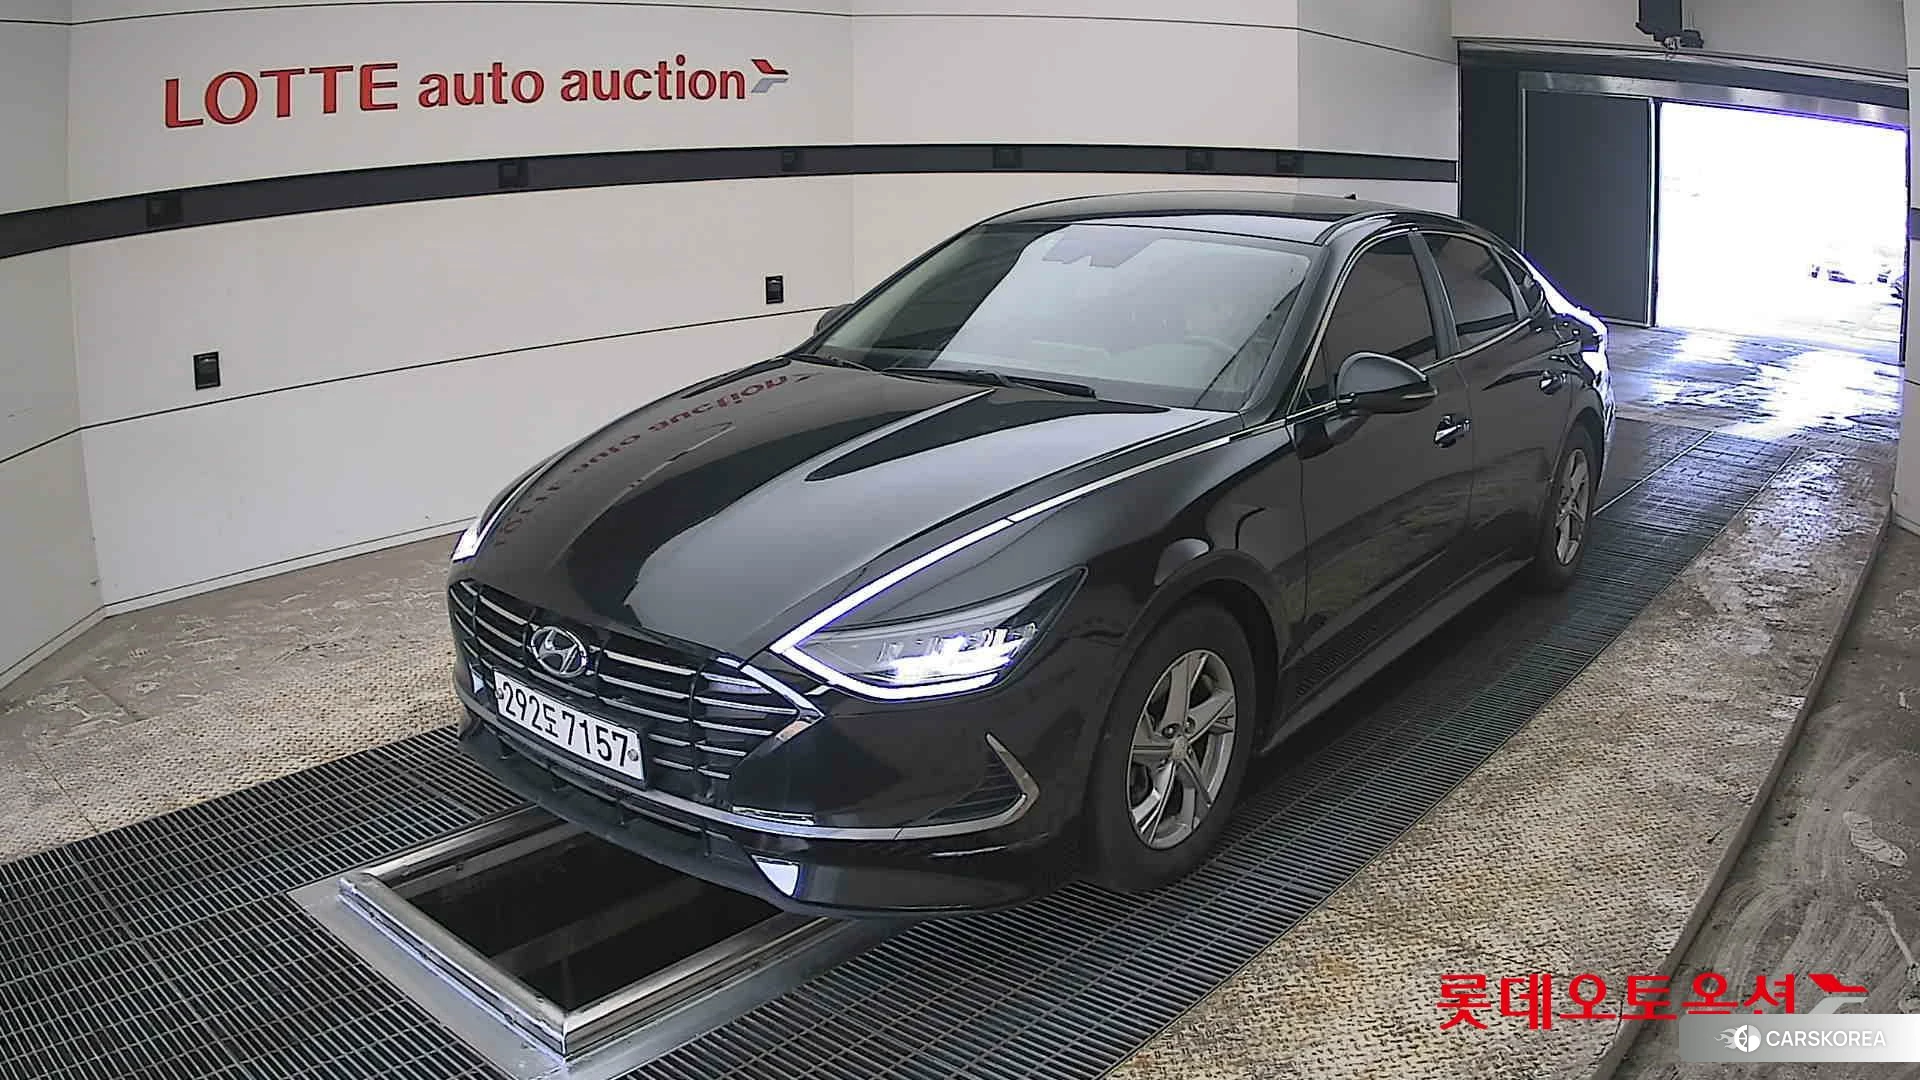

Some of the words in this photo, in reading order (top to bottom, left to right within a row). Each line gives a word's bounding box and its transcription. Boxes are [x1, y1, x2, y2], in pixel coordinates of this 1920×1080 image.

[164, 62, 399, 129] LOTTE
[418, 62, 546, 108] auto
[560, 54, 747, 102] auction
